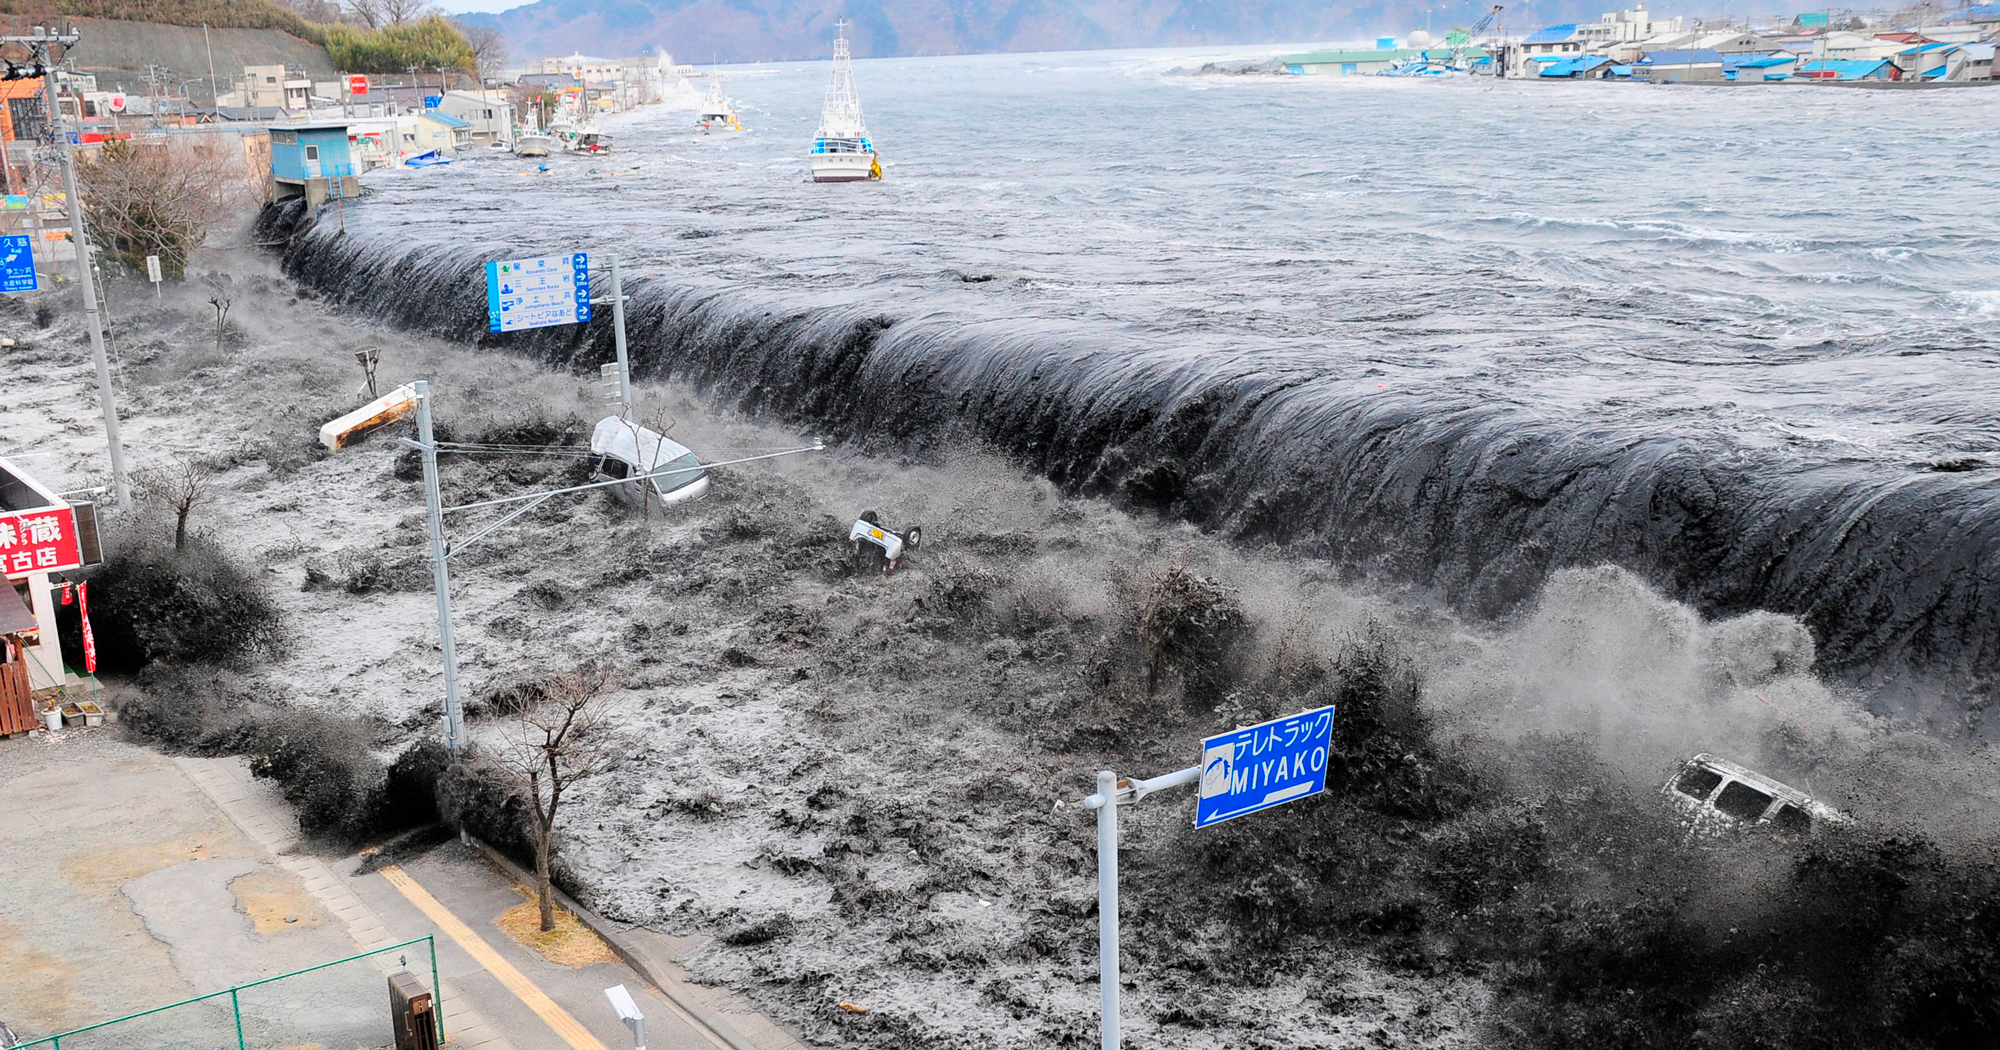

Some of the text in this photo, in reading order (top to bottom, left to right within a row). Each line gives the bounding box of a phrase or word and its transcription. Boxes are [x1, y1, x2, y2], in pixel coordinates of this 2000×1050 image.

[515, 274, 570, 288] 三王岩
[517, 308, 572, 323] シートピアなあど
[1235, 712, 1331, 761] テレトラック
[1230, 746, 1325, 796] MIYAKO
